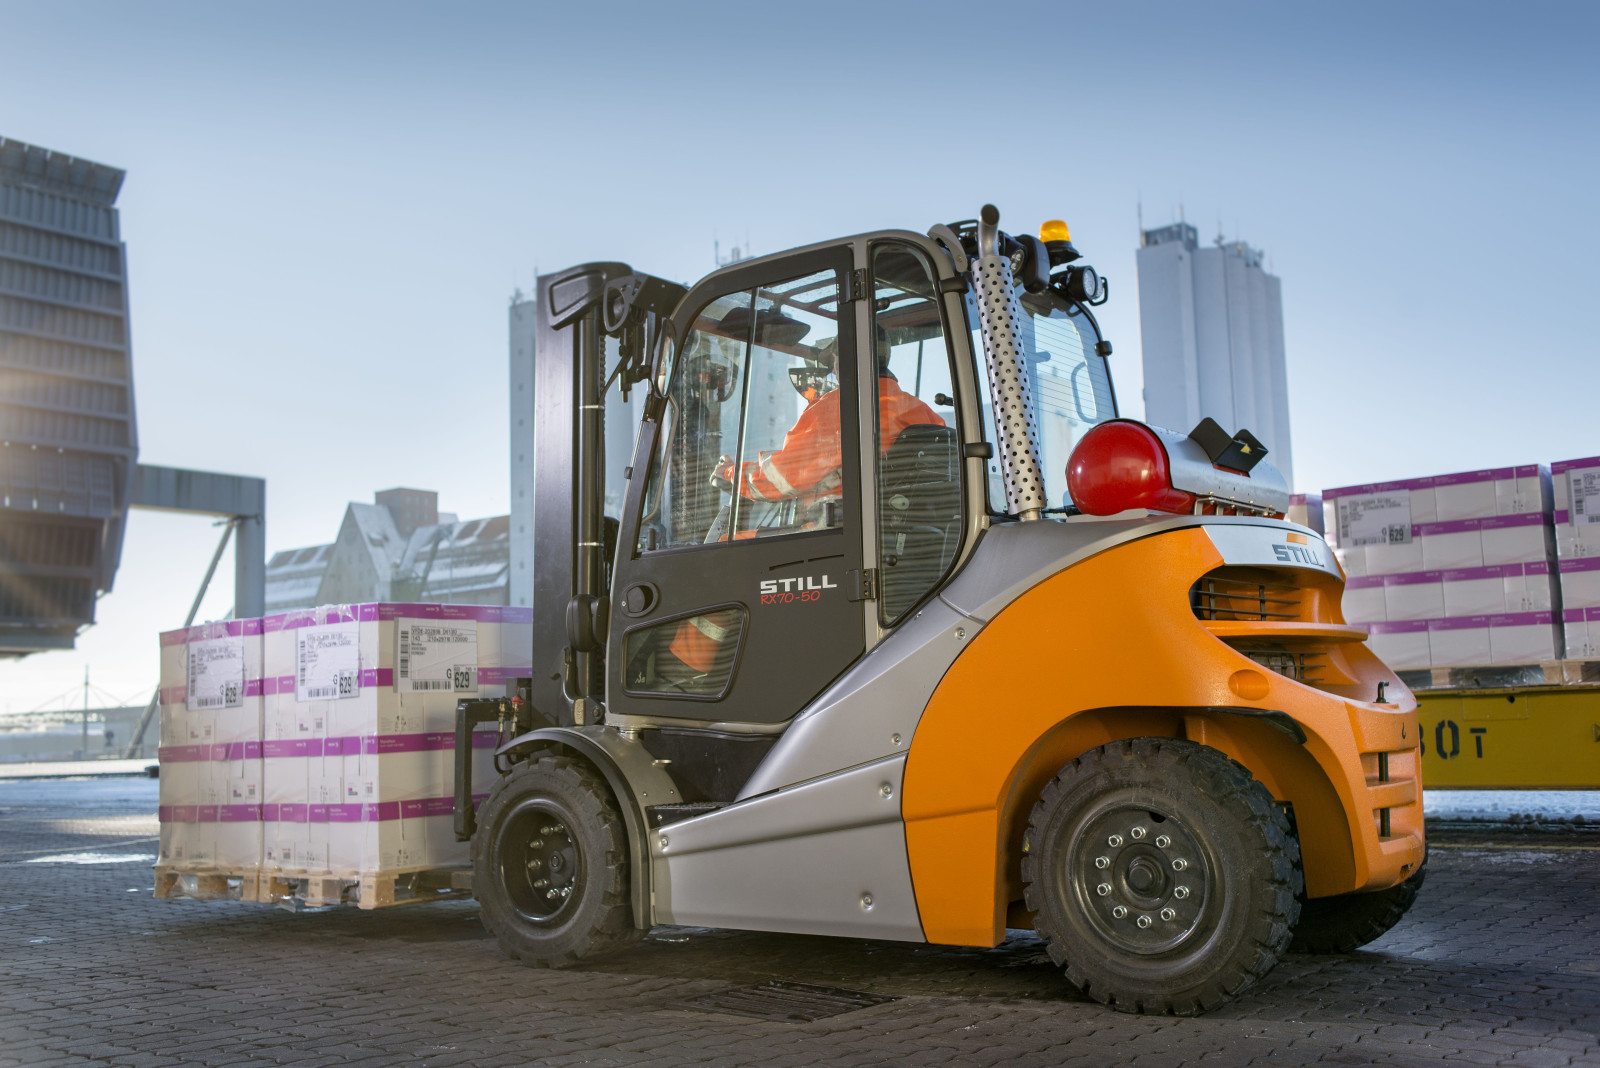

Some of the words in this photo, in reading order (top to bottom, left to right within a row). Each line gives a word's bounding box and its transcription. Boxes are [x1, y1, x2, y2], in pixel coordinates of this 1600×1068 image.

[1389, 528, 1404, 542] 629
[1272, 544, 1325, 568] STILL
[760, 574, 837, 595] STILL
[760, 590, 821, 605] RX70-50
[339, 676, 352, 694] 629
[446, 668, 452, 679] G
[454, 671, 470, 689] 629
[225, 687, 237, 703] 629
